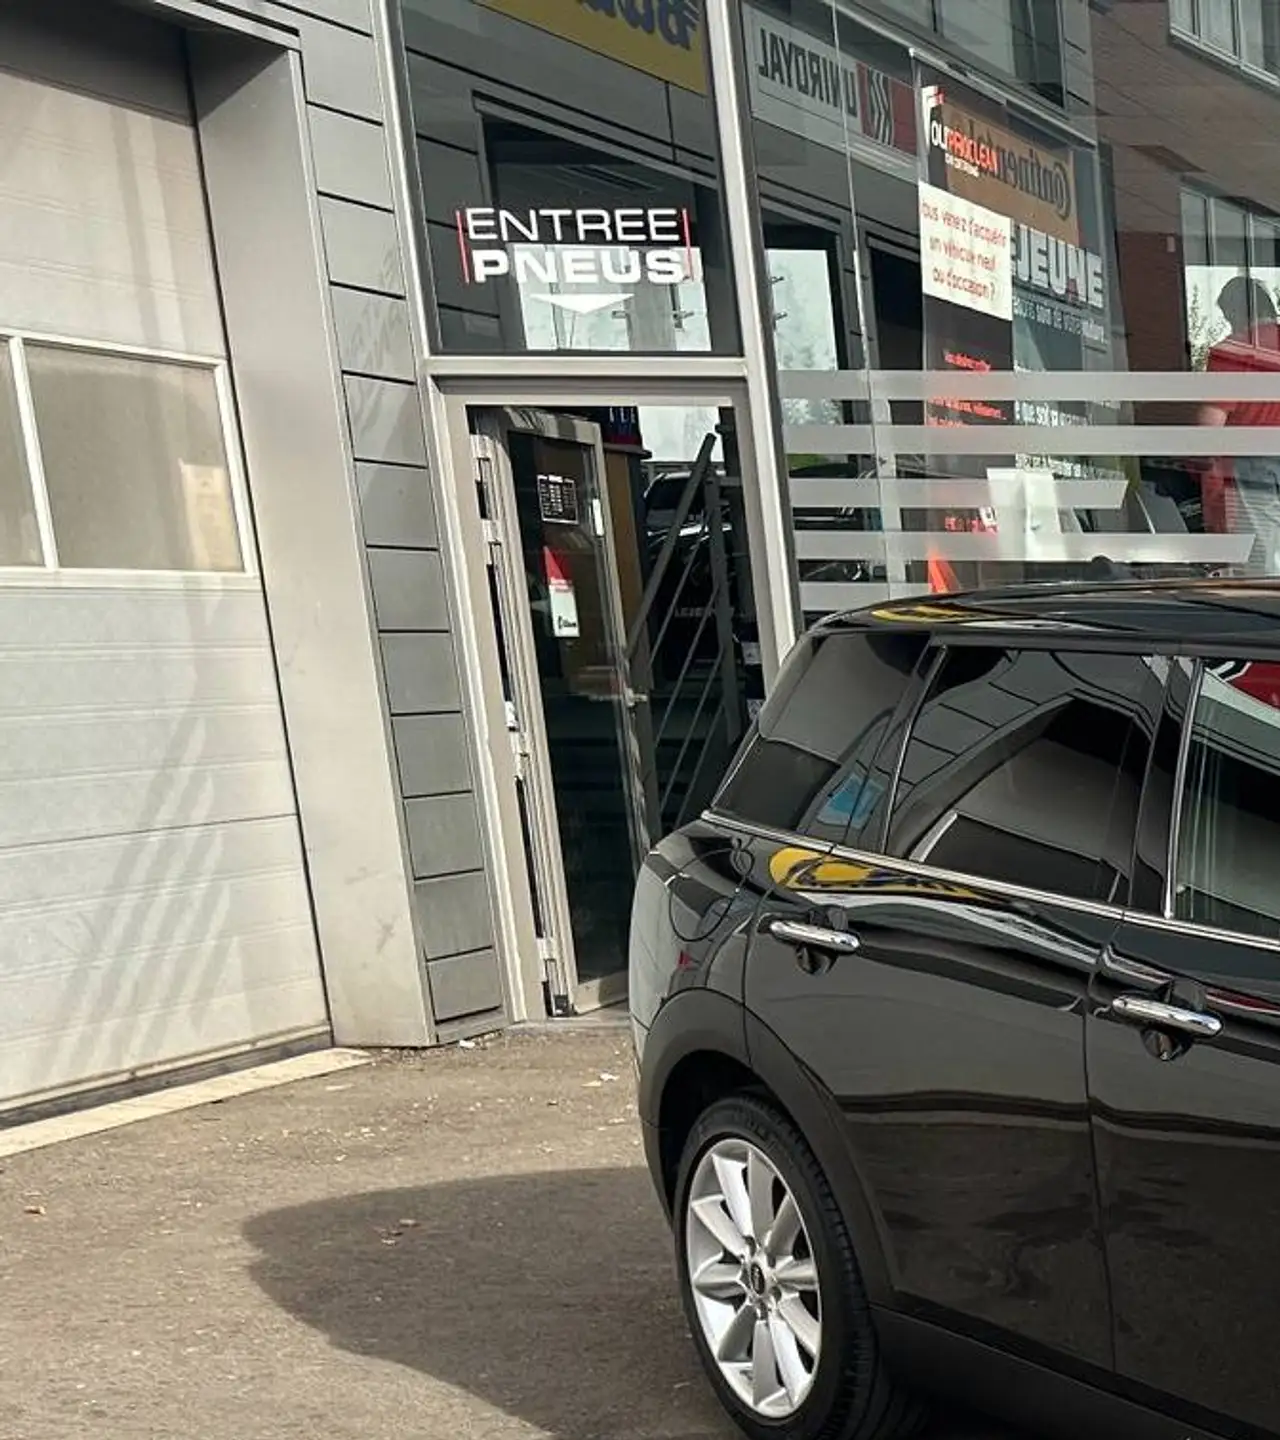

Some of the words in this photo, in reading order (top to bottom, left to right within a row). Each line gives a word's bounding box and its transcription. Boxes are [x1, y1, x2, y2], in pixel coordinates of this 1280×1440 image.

[465, 207, 680, 242] ENTREE
[471, 249, 684, 284] PNEUS
[1011, 220, 1104, 308] JEUNE
